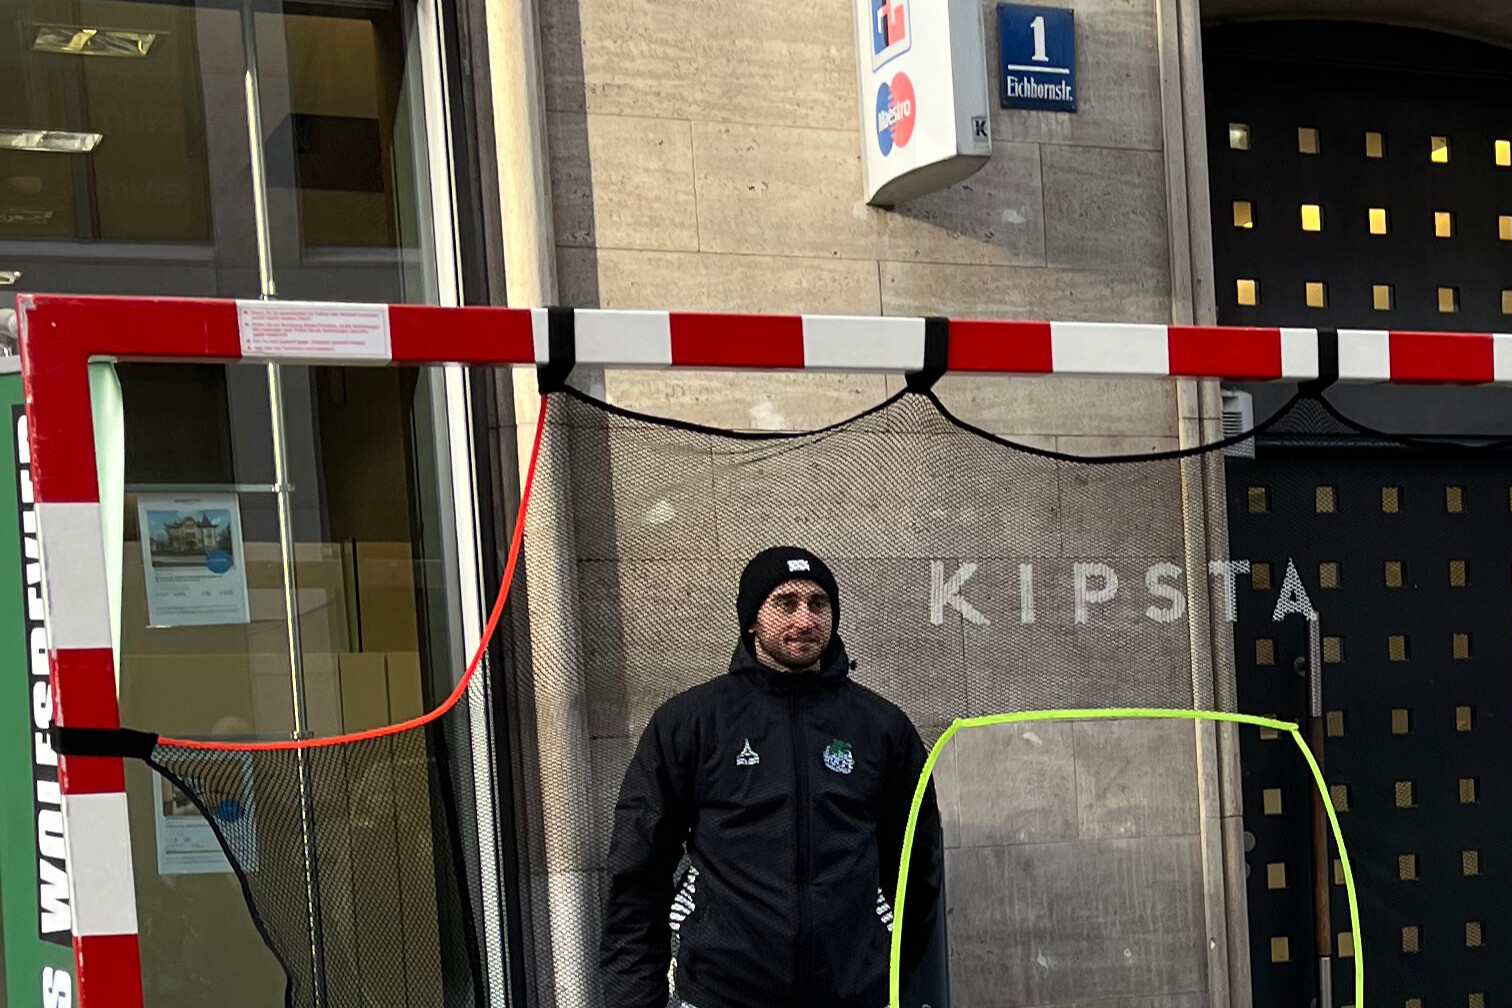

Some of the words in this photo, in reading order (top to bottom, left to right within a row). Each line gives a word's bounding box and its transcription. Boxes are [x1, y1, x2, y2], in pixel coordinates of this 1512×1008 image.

[1030, 16, 1049, 62] 1
[1007, 76, 1073, 101] Eichhornstr.
[930, 558, 1319, 626] KIPSTA
